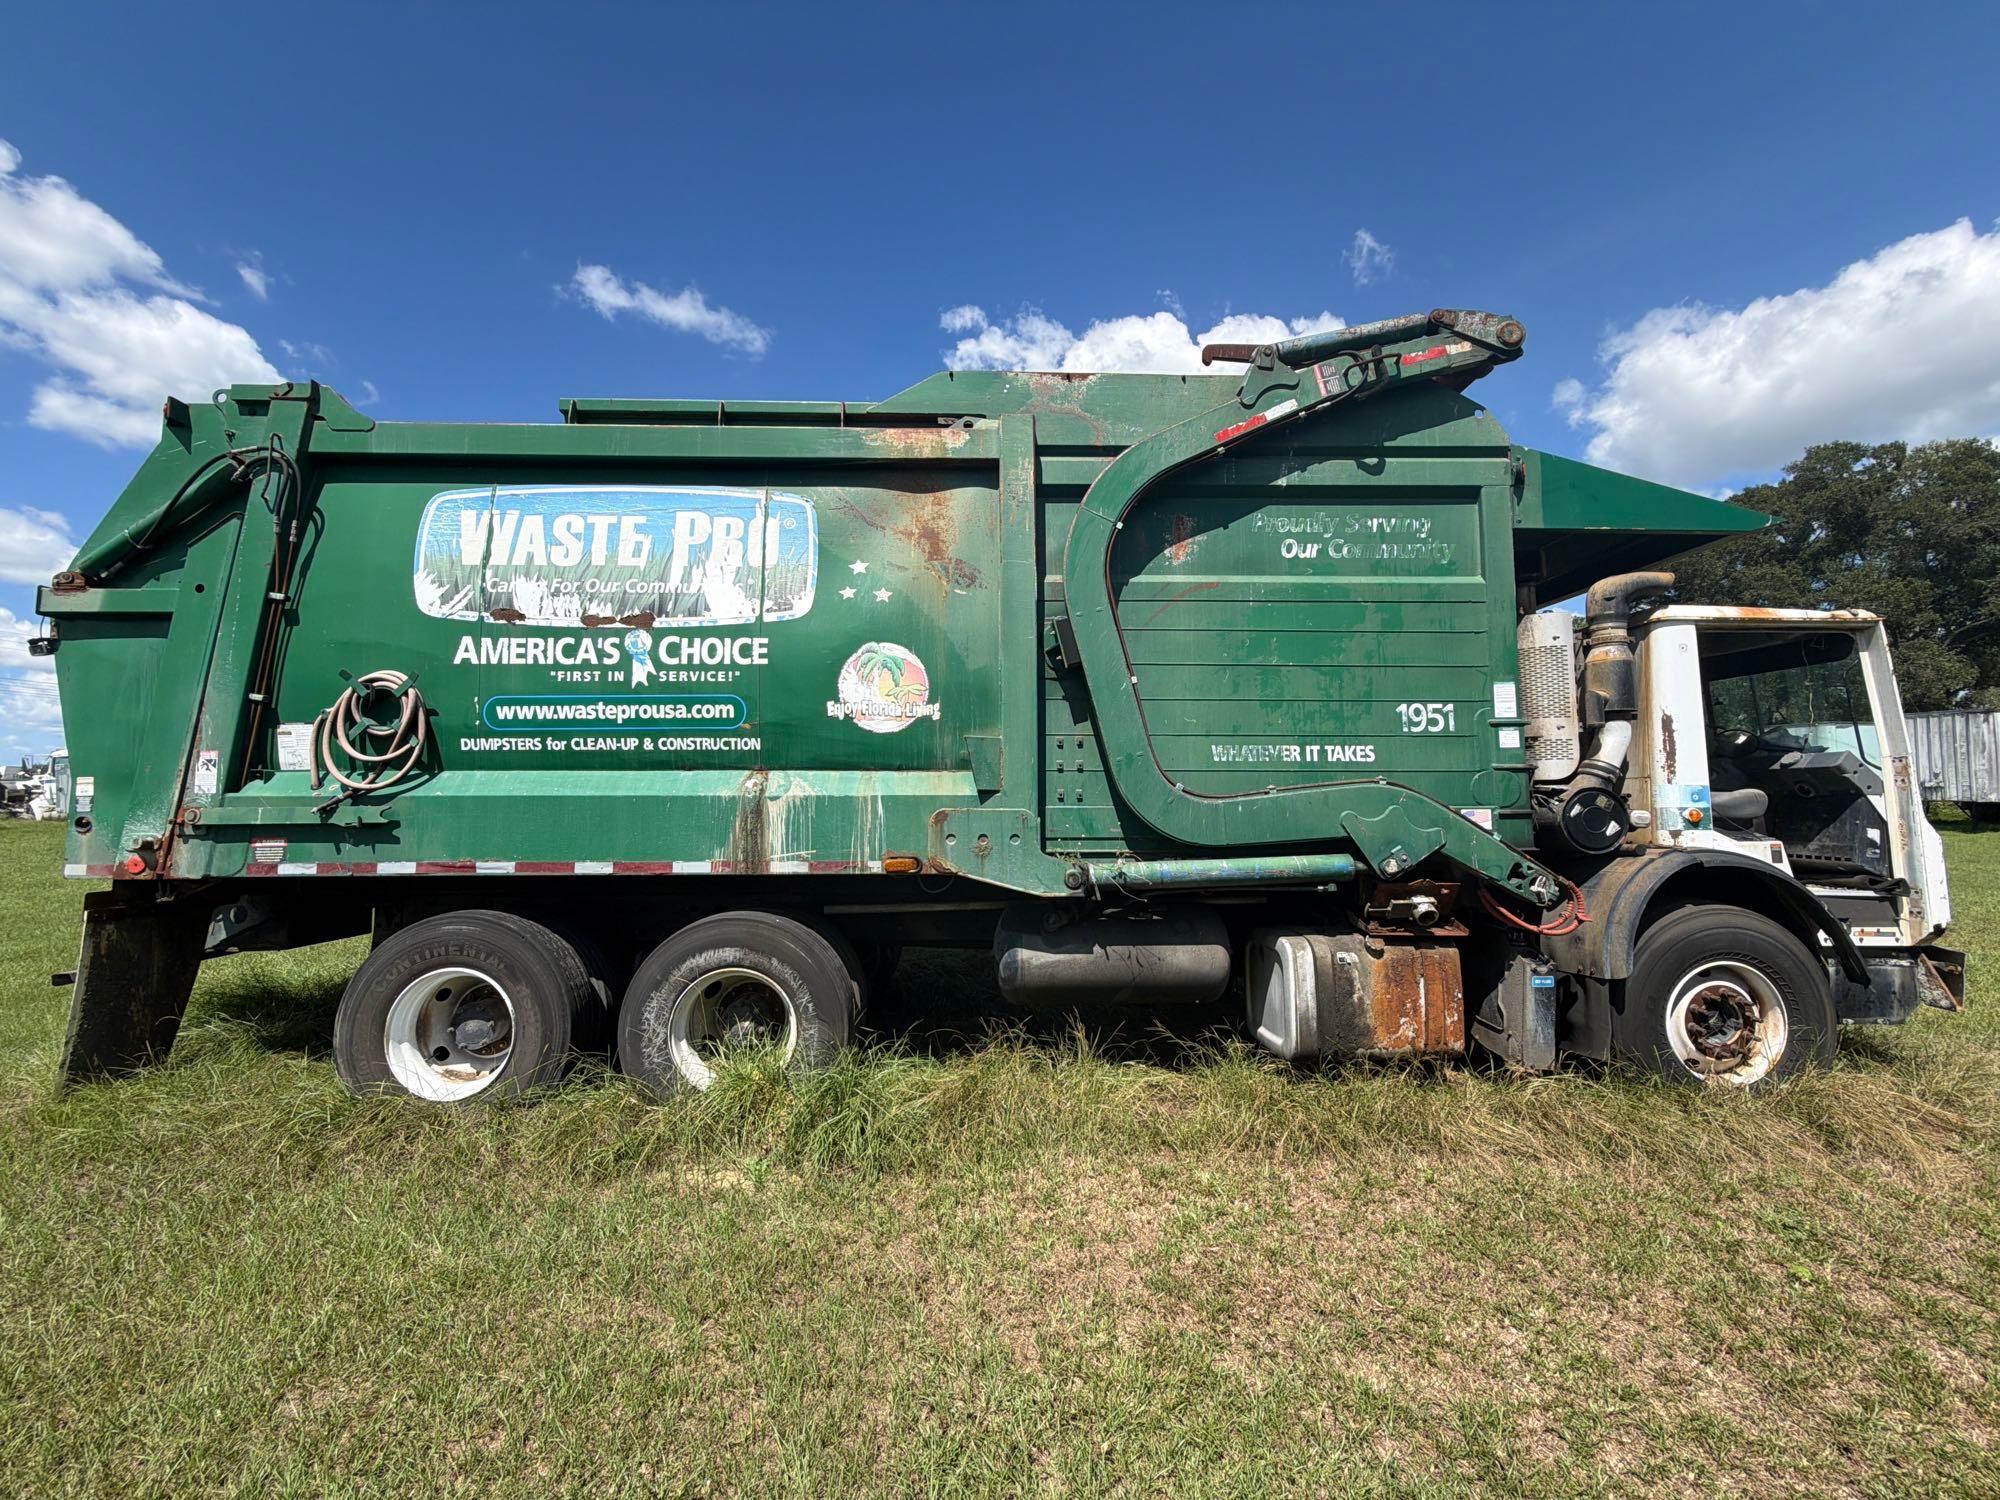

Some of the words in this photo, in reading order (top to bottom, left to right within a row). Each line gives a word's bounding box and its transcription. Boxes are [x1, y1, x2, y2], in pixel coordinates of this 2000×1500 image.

[1251, 512, 1339, 538] Proudly
[1345, 513, 1431, 538] Serving
[461, 510, 649, 567] WASTE
[1281, 539, 1322, 558] Our
[1328, 537, 1456, 564] Community
[551, 578, 580, 592] For
[585, 578, 619, 592] Our
[453, 636, 620, 665] AMERICA'S
[658, 635, 769, 665] CHOICE
[608, 671, 624, 682] IN
[495, 701, 735, 724] www.wasteprousa.com
[826, 700, 858, 720] Enjoy
[861, 700, 902, 717] Florida
[1395, 703, 1455, 732] 1951
[460, 738, 542, 751] DUMPSTERS
[546, 737, 567, 751] for
[571, 738, 639, 750] CLEAN-UP
[643, 738, 654, 750] &
[658, 738, 761, 750] CONSTRUCTION
[1211, 745, 1301, 762] WHATEVER
[1305, 745, 1320, 761] IT
[1324, 745, 1376, 762] TAKES
